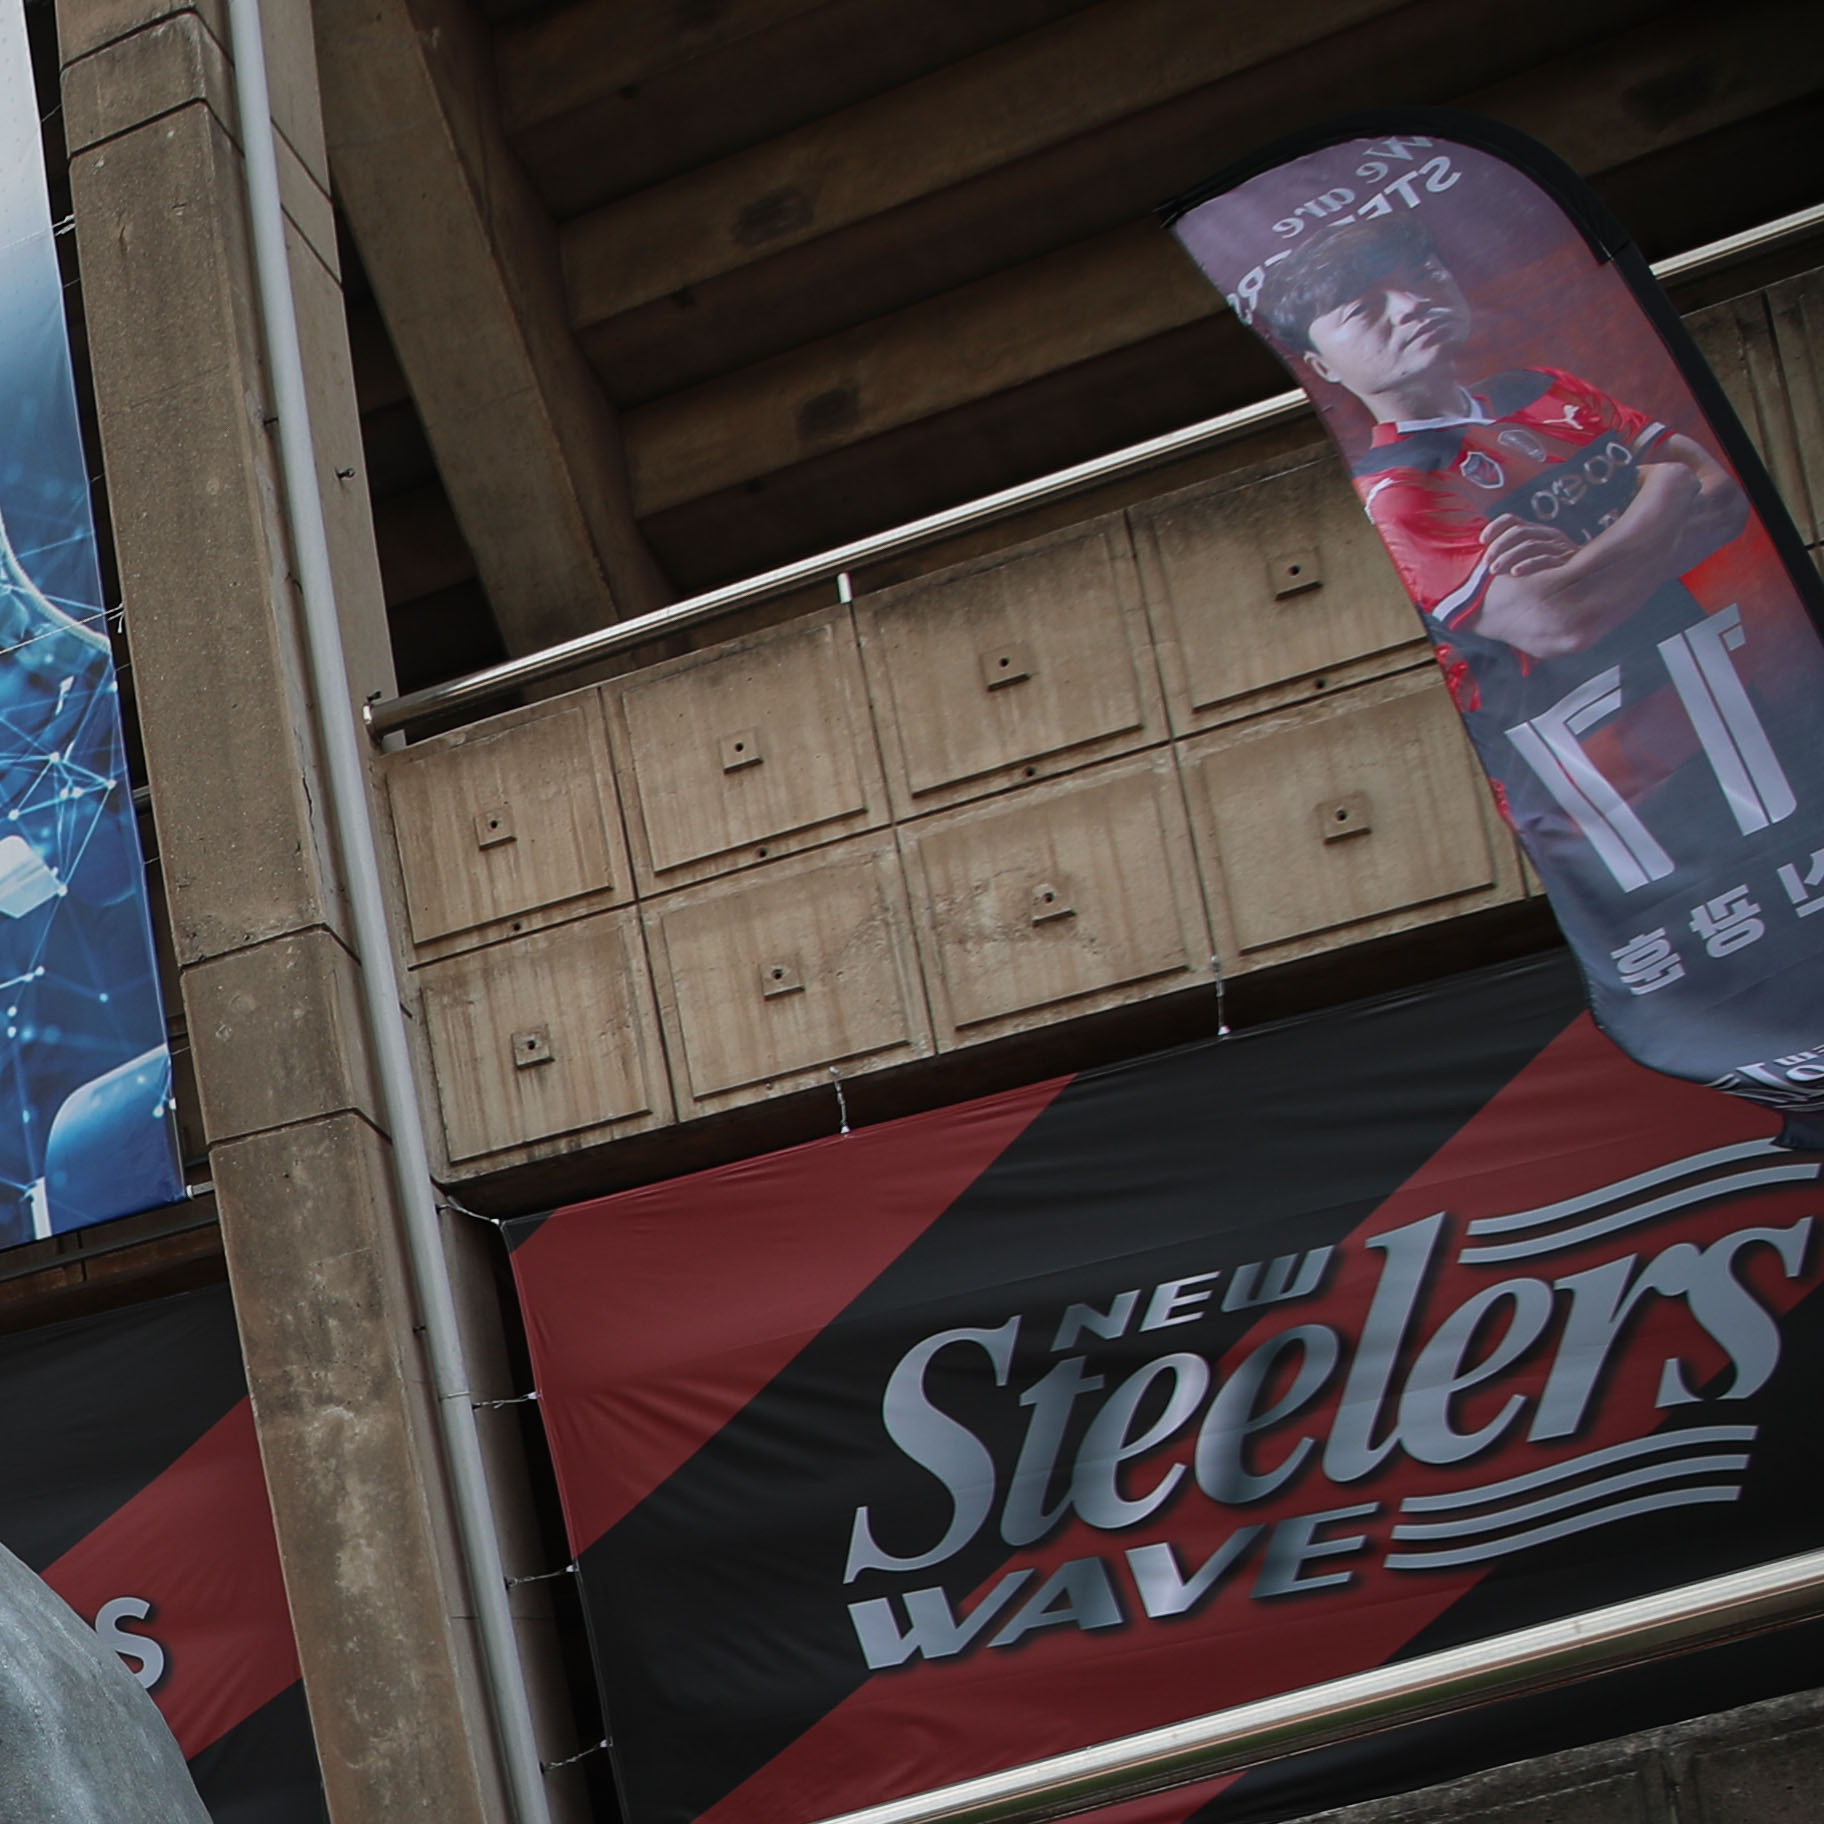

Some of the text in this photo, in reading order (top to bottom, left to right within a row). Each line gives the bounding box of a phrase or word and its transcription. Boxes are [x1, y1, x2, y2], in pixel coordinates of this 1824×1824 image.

[1049, 1245, 1334, 1353] NEW
[843, 1211, 1814, 1584] Steelers
[846, 1503, 1380, 1671] WAVE
